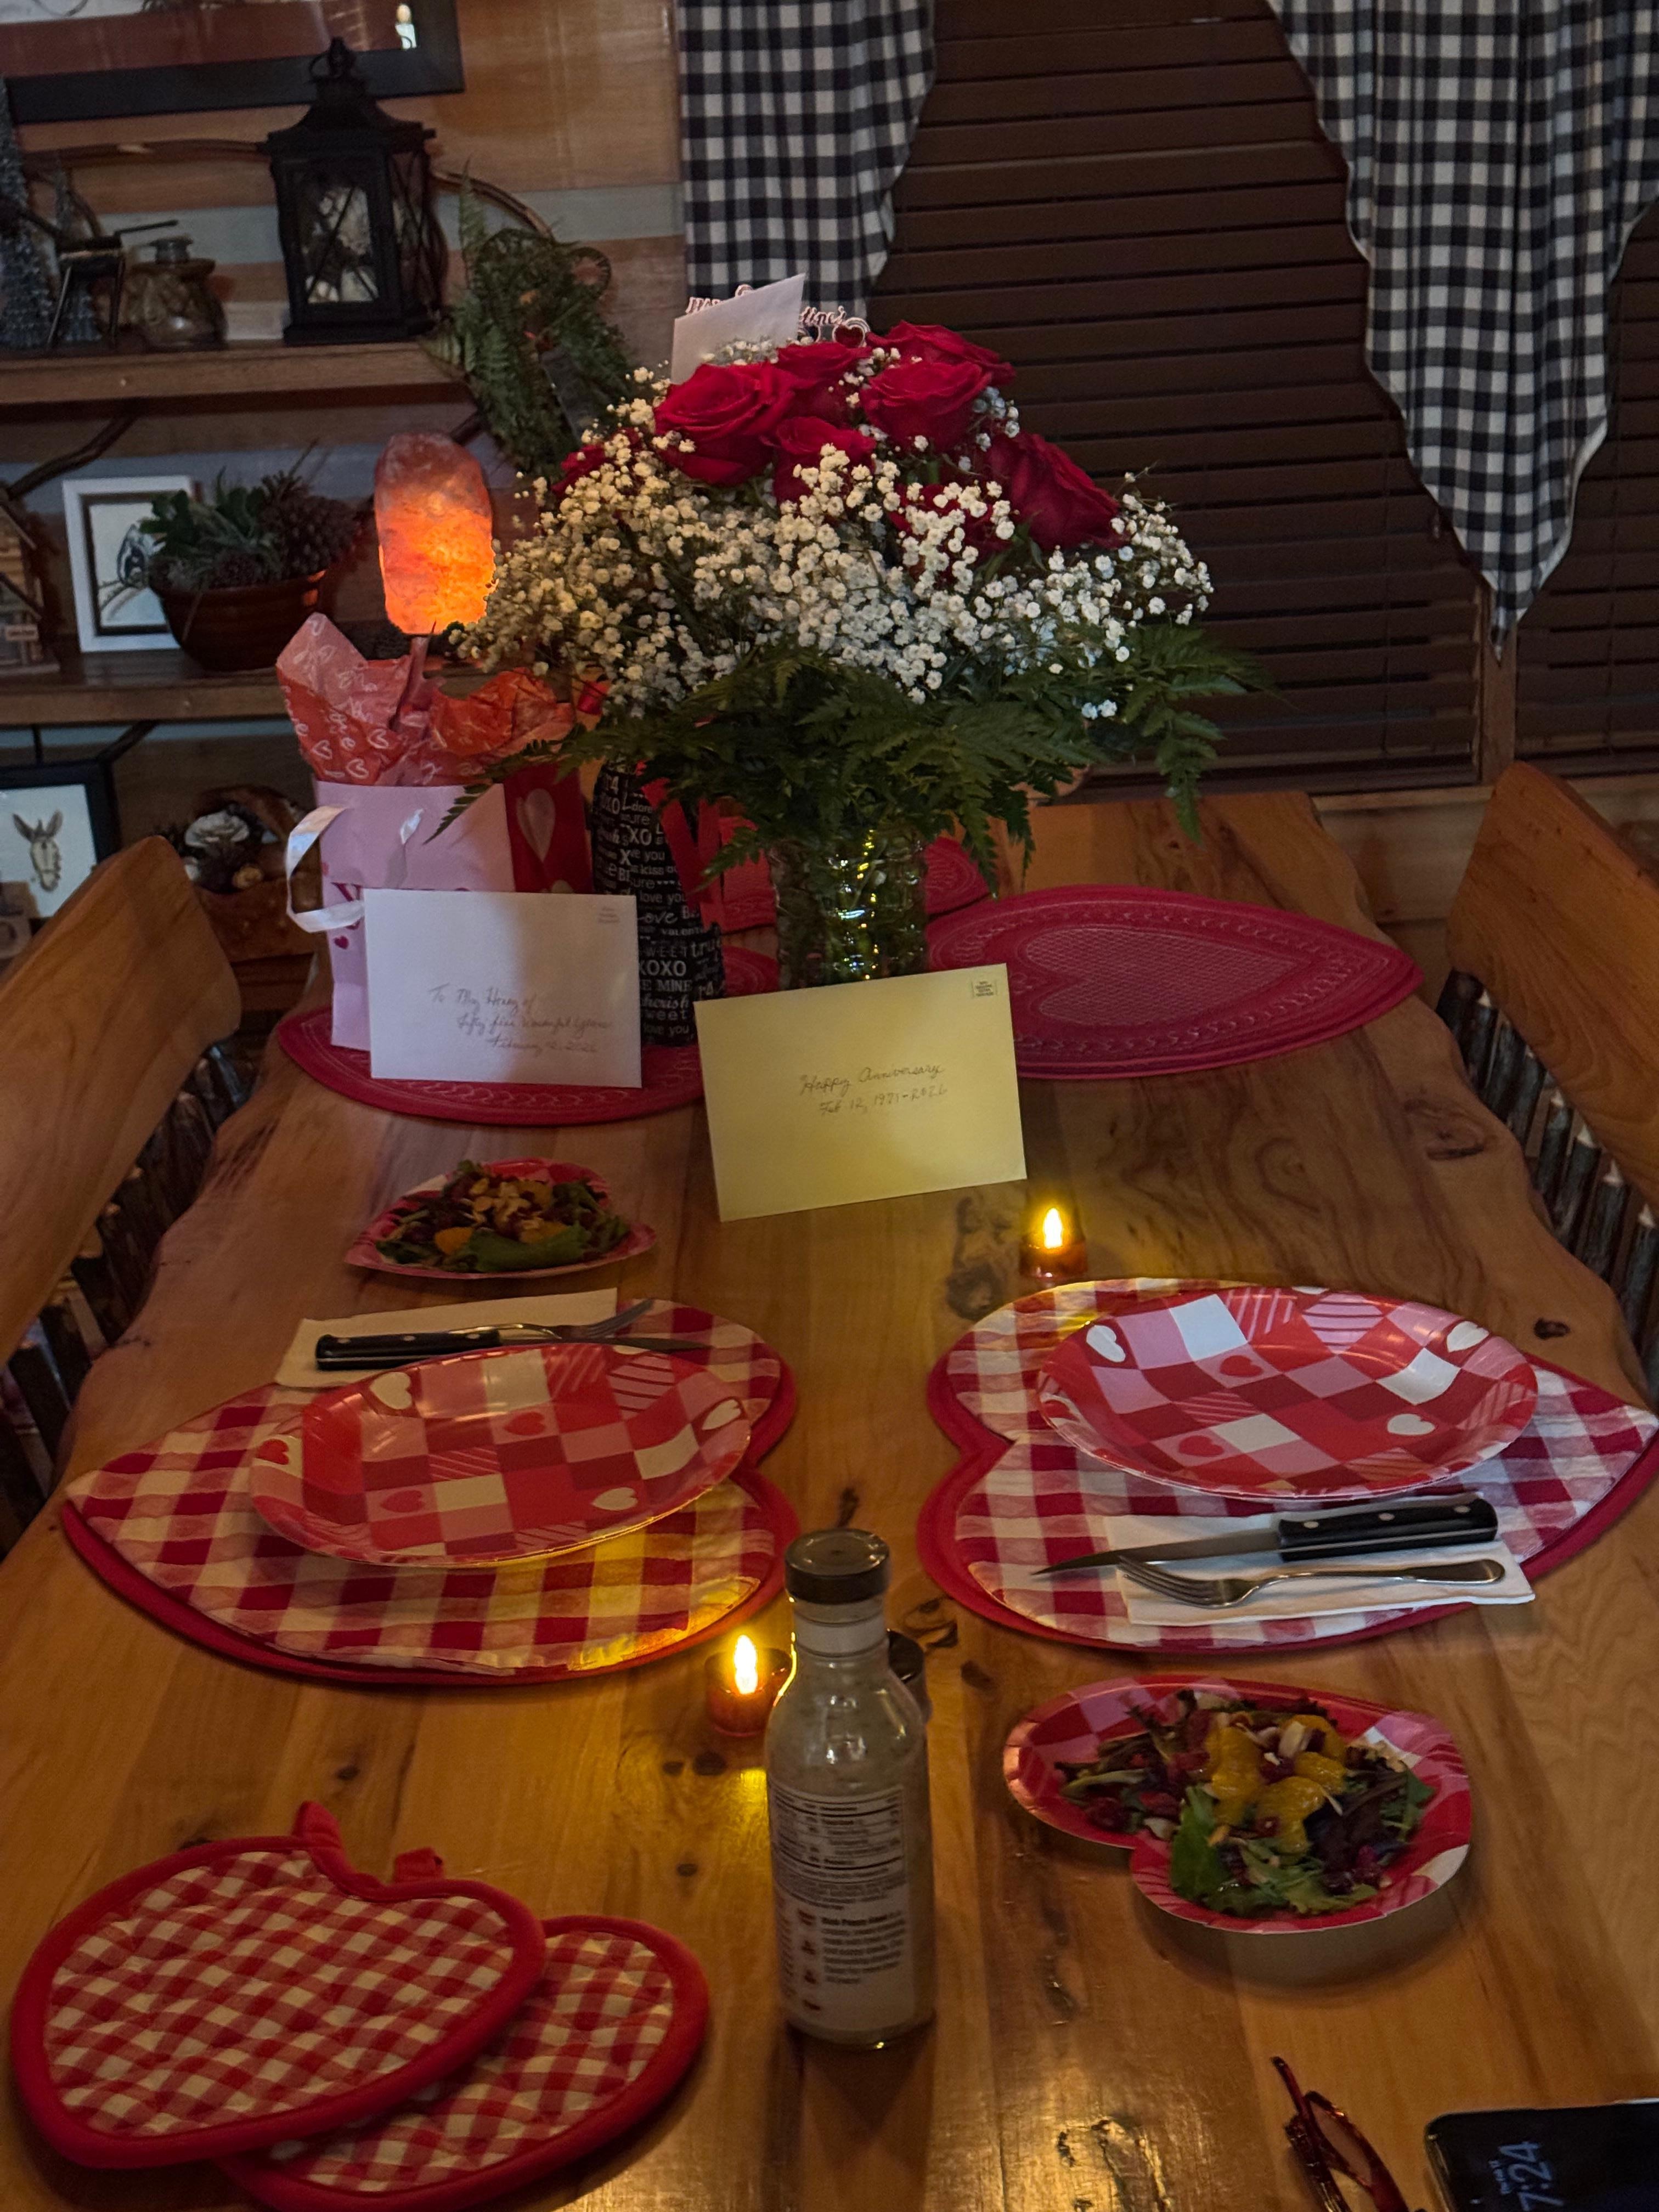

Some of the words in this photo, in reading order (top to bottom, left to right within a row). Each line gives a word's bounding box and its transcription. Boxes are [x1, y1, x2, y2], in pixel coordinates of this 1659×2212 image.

[428, 983, 450, 1003] To
[657, 979, 692, 992] MINE
[799, 1074, 851, 1098] Happy
[858, 1064, 945, 1083] Anniversary
[1497, 2141, 1564, 2211] 7:24
